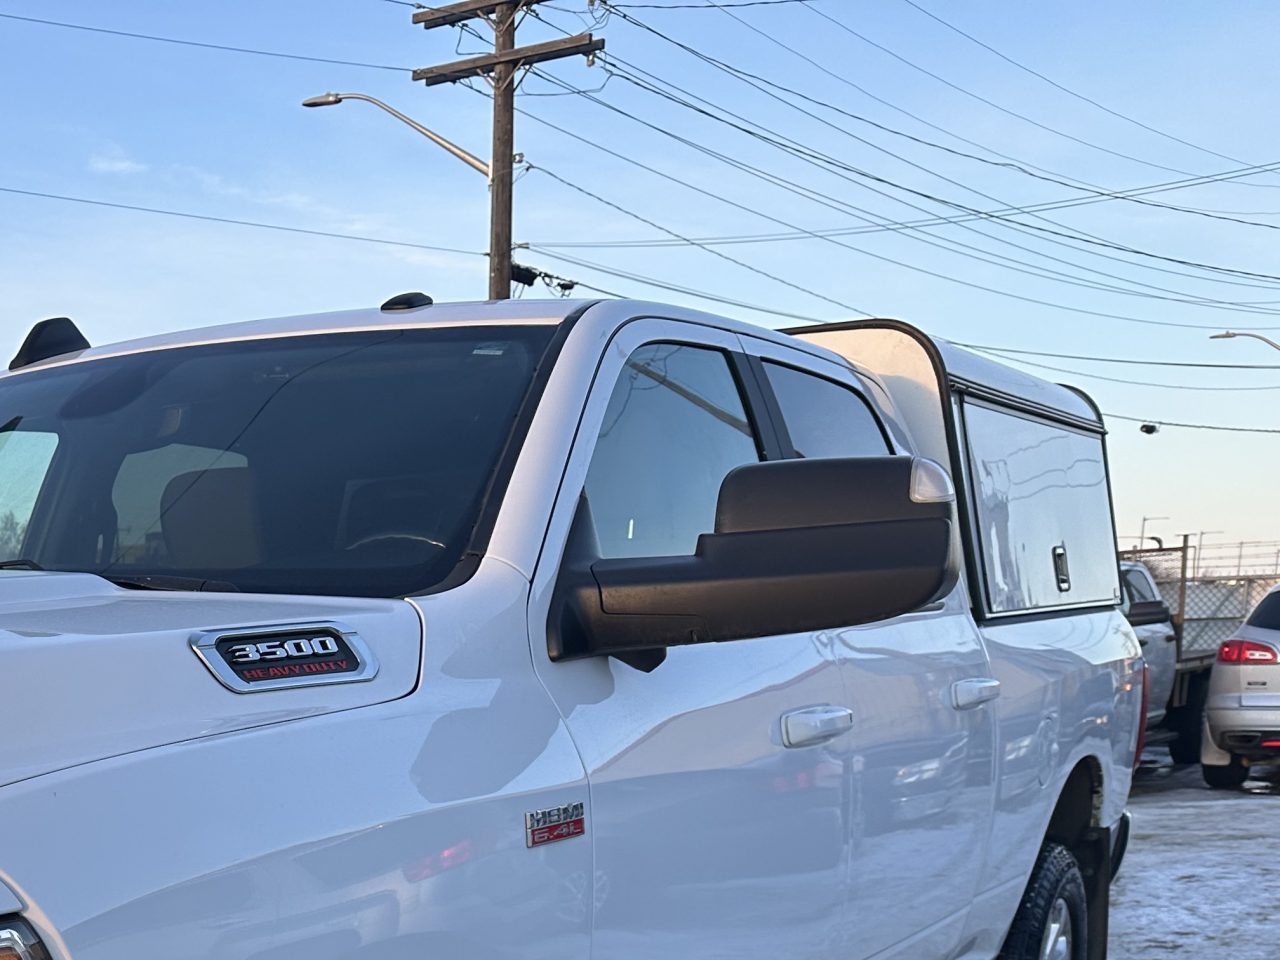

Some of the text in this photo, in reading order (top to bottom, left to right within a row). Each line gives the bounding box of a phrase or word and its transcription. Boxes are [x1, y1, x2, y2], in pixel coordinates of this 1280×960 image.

[229, 637, 339, 663] 3500
[243, 660, 349, 679] HEAVY DUTY
